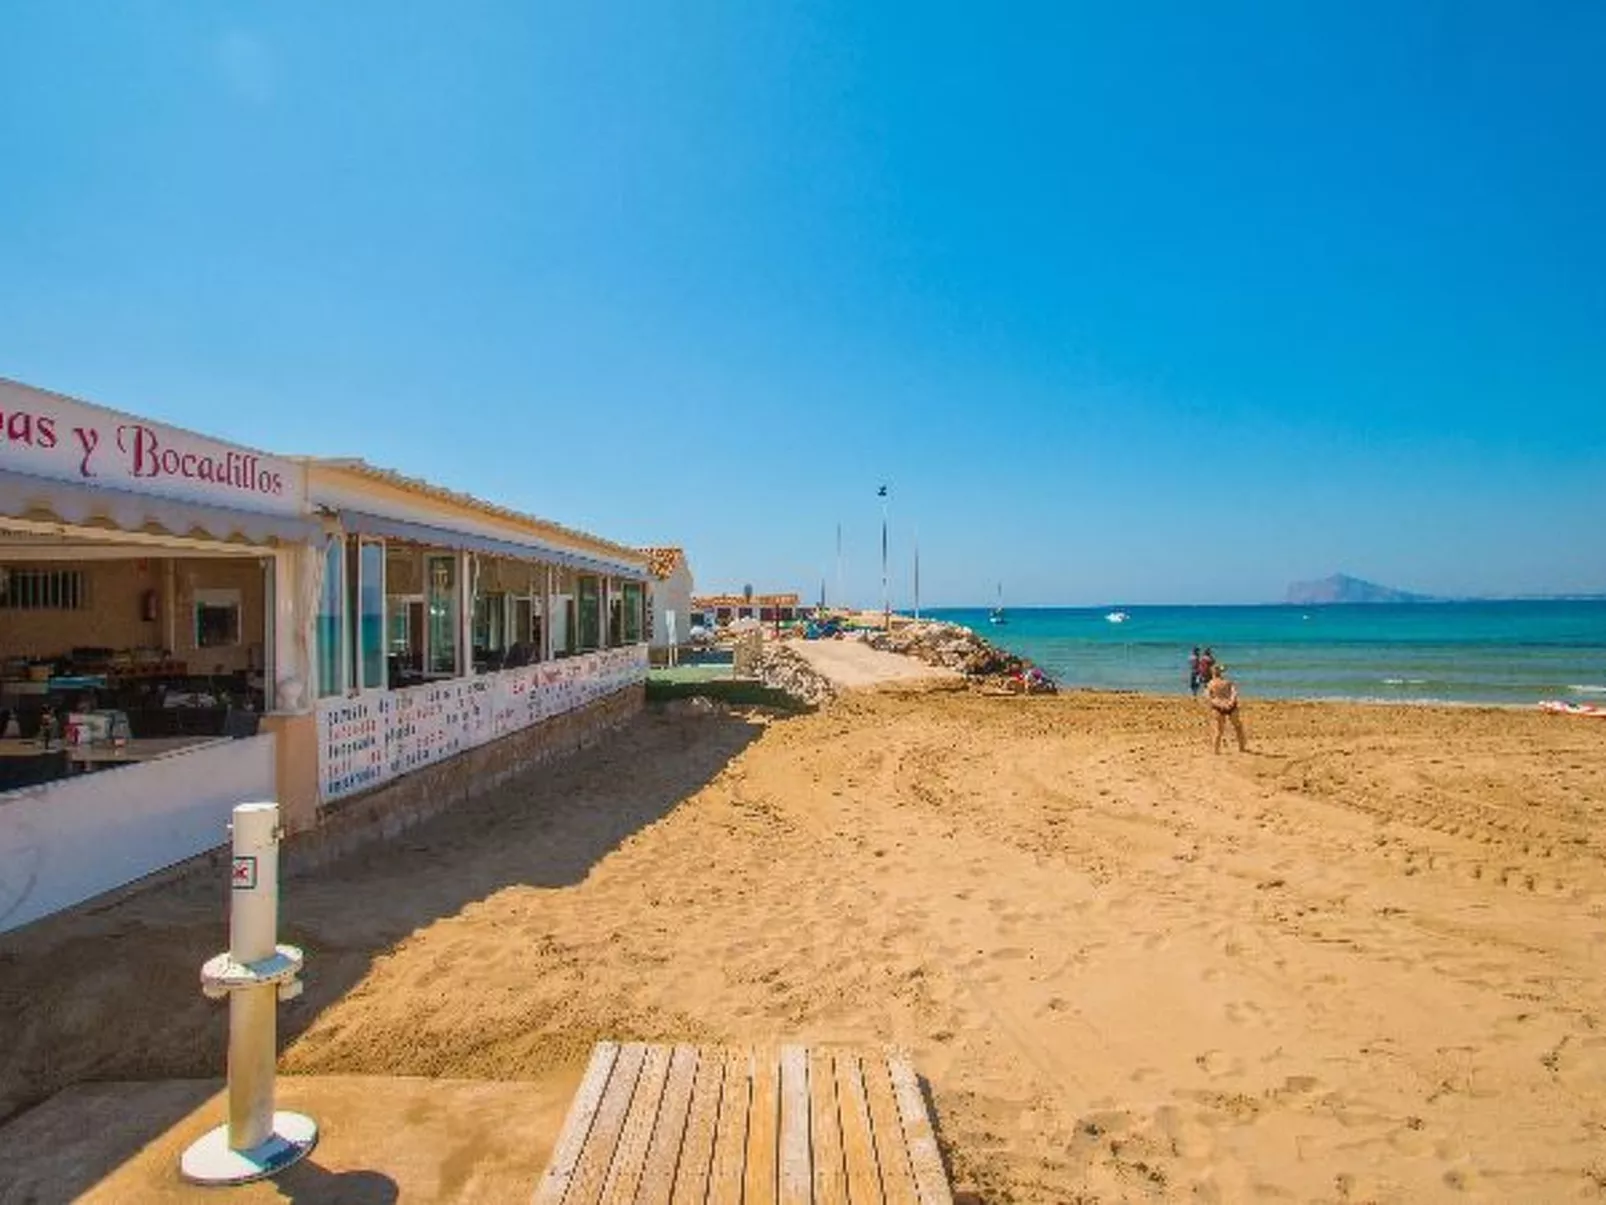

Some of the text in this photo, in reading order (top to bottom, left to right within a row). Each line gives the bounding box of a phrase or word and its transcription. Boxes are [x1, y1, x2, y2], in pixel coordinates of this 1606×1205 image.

[0, 411, 283, 495] as y Bocadillos
